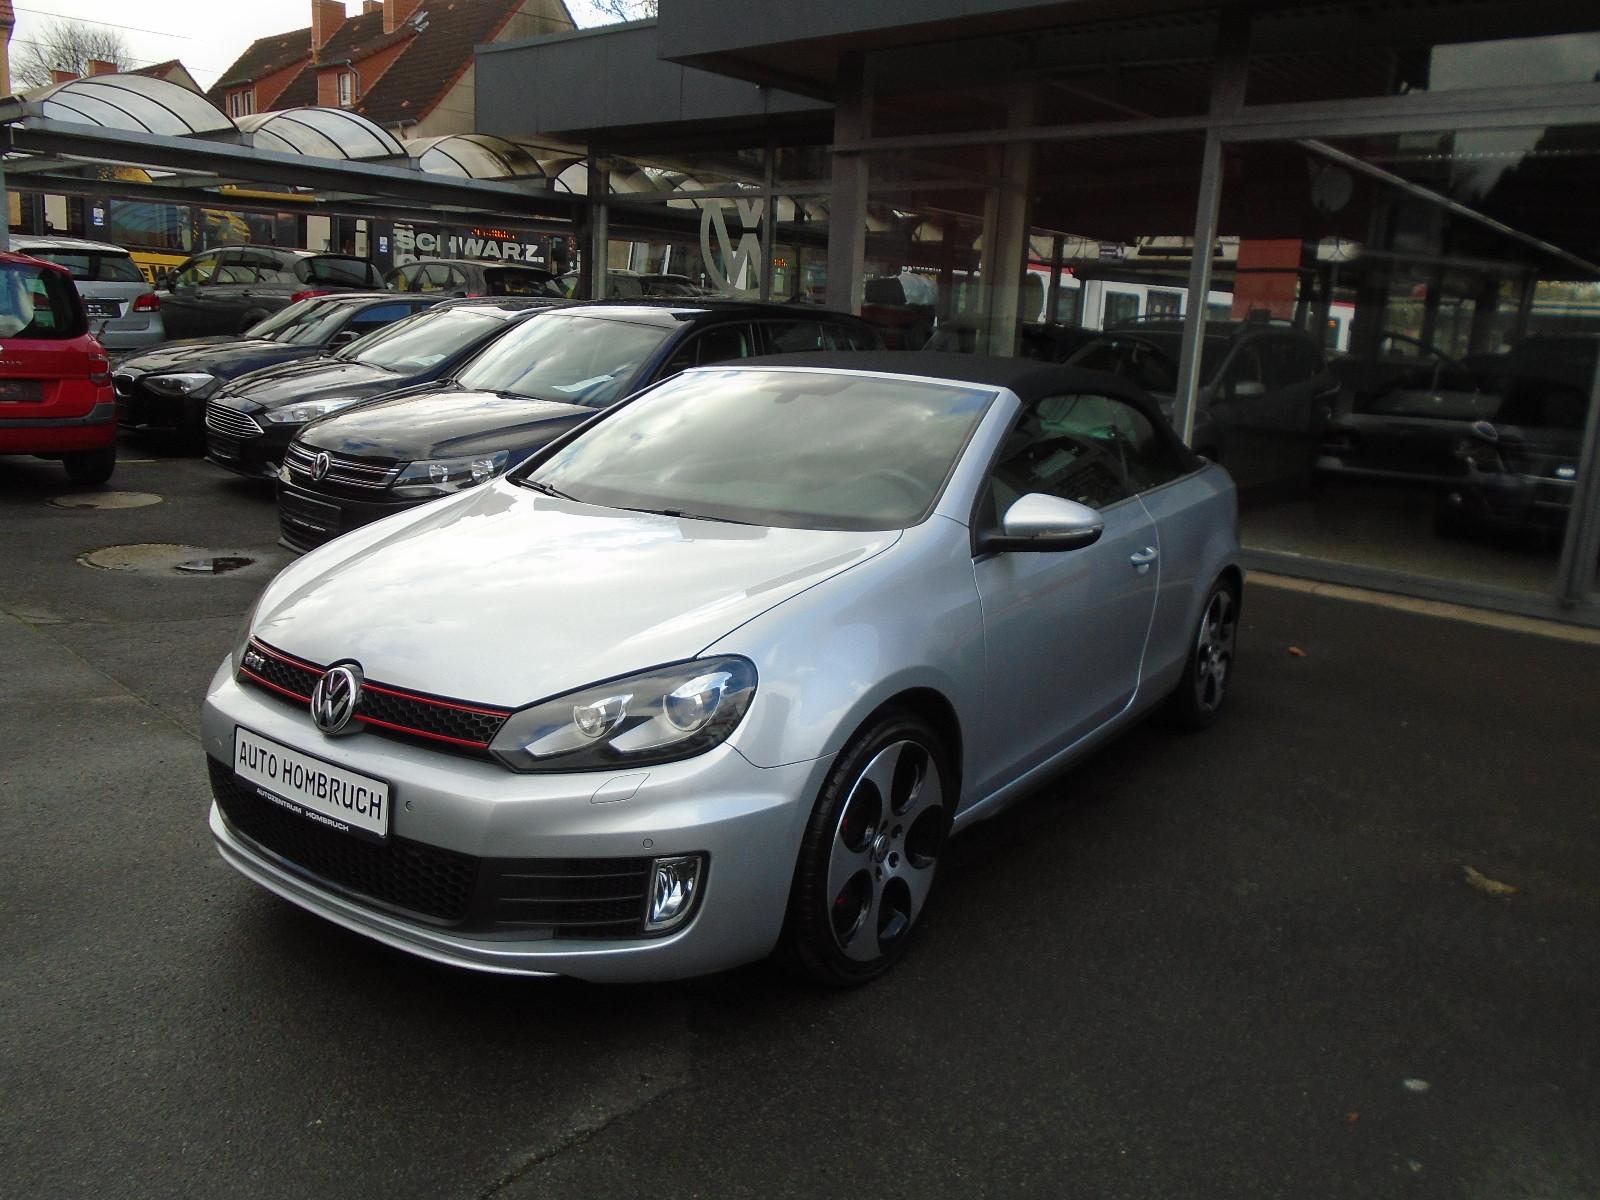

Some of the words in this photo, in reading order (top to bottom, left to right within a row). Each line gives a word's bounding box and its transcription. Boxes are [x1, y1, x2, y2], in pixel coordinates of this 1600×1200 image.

[239, 740, 278, 778] AUTO
[282, 758, 382, 820] HOMBRUCH
[256, 787, 302, 814] AUTOZENTRUM
[305, 810, 349, 833] HOMBRUCH
